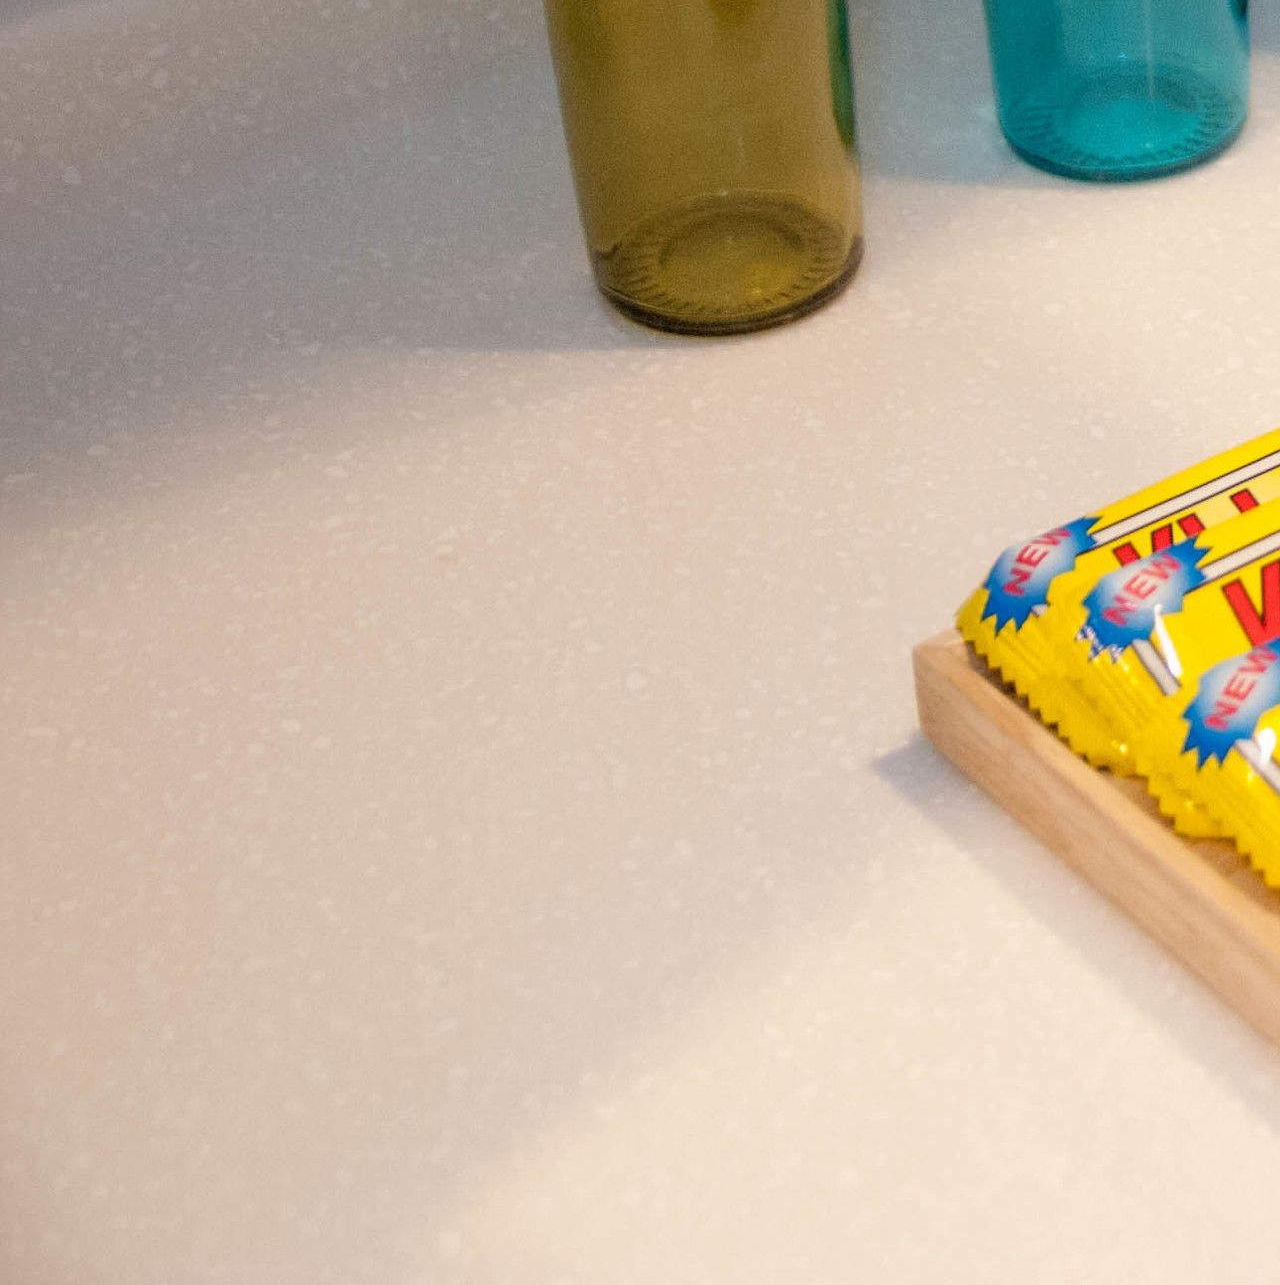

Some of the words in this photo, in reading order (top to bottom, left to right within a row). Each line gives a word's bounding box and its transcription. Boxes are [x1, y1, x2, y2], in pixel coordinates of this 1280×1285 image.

[1003, 526, 1074, 596] NEW
[1102, 552, 1182, 627] NEW
[1203, 644, 1280, 731] NEW
